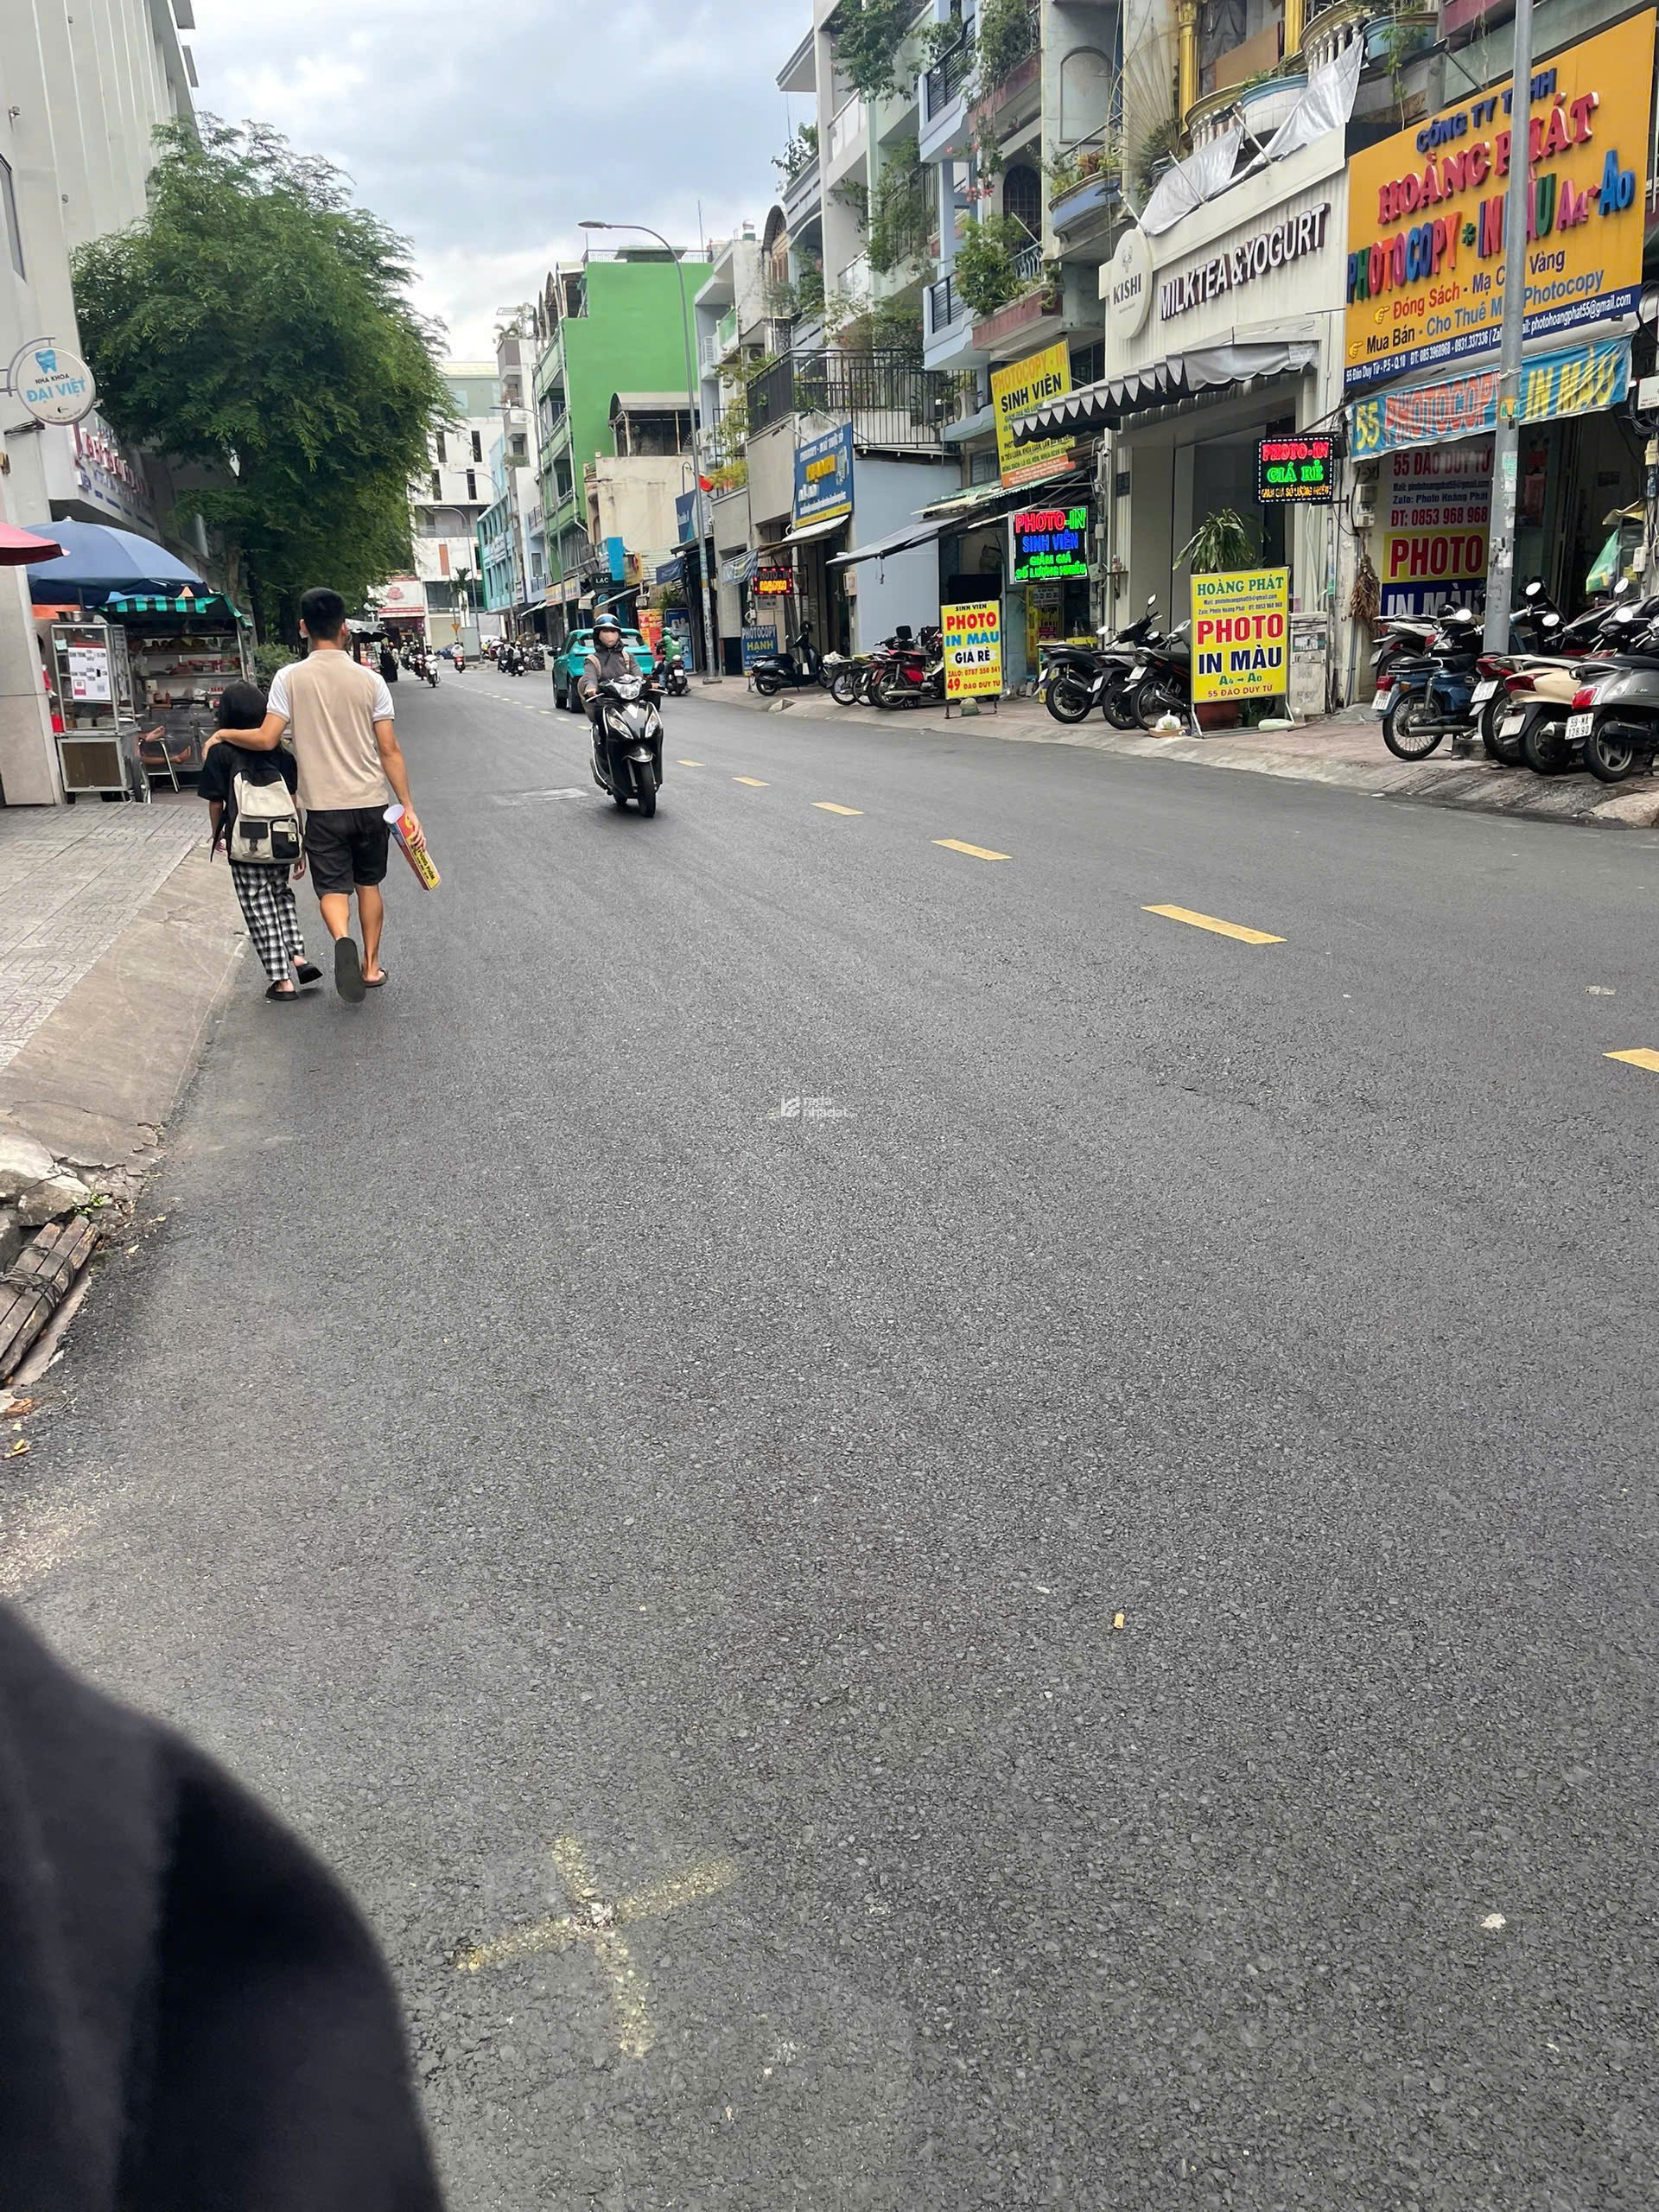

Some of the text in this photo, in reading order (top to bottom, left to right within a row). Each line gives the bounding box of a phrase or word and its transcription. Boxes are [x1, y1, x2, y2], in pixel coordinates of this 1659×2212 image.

[1416, 67, 1557, 153] CÔNG TY THH
[1346, 212, 1463, 306] PHOTOCOPY
[1113, 273, 1142, 305] KISHI
[1393, 296, 1425, 320] Đóng
[1429, 282, 1460, 308] Sách
[1472, 273, 1491, 296] Mạ
[1529, 250, 1565, 275] Vàng
[1366, 337, 1389, 354] Mua
[1393, 325, 1415, 346] Bán
[1427, 316, 1452, 336] Cho
[1455, 301, 1486, 326] Thuê
[1523, 270, 1604, 308] Photocopy
[27, 376, 86, 404] ĐẠI VIỆT
[1001, 372, 1062, 413] SINH VIÊN
[1356, 401, 1381, 450] 55
[1526, 367, 1554, 421] IN
[1267, 460, 1323, 482] GIÁ RẺ
[1394, 453, 1410, 476] 55
[1393, 495, 1414, 505] Zalo:
[1415, 494, 1439, 503] Photo
[1391, 505, 1488, 527] ĐT: 0853 968 968
[1022, 529, 1079, 553] SINH VIÊN
[1389, 534, 1484, 578] PHOTO
[1197, 574, 1284, 595] HOÀNG PHÁT
[1387, 593, 1414, 616] IN
[741, 626, 776, 639] PHOTOCOPY
[946, 612, 996, 631] PHOTO
[1198, 613, 1284, 645] PHOTO
[747, 640, 774, 652] HẠNH
[945, 629, 1000, 647] IN MÀU
[955, 646, 990, 664] GIÁ RẺ
[1198, 645, 1282, 674] IN MÀU
[947, 677, 961, 691] 49
[1243, 686, 1261, 695] DUY
